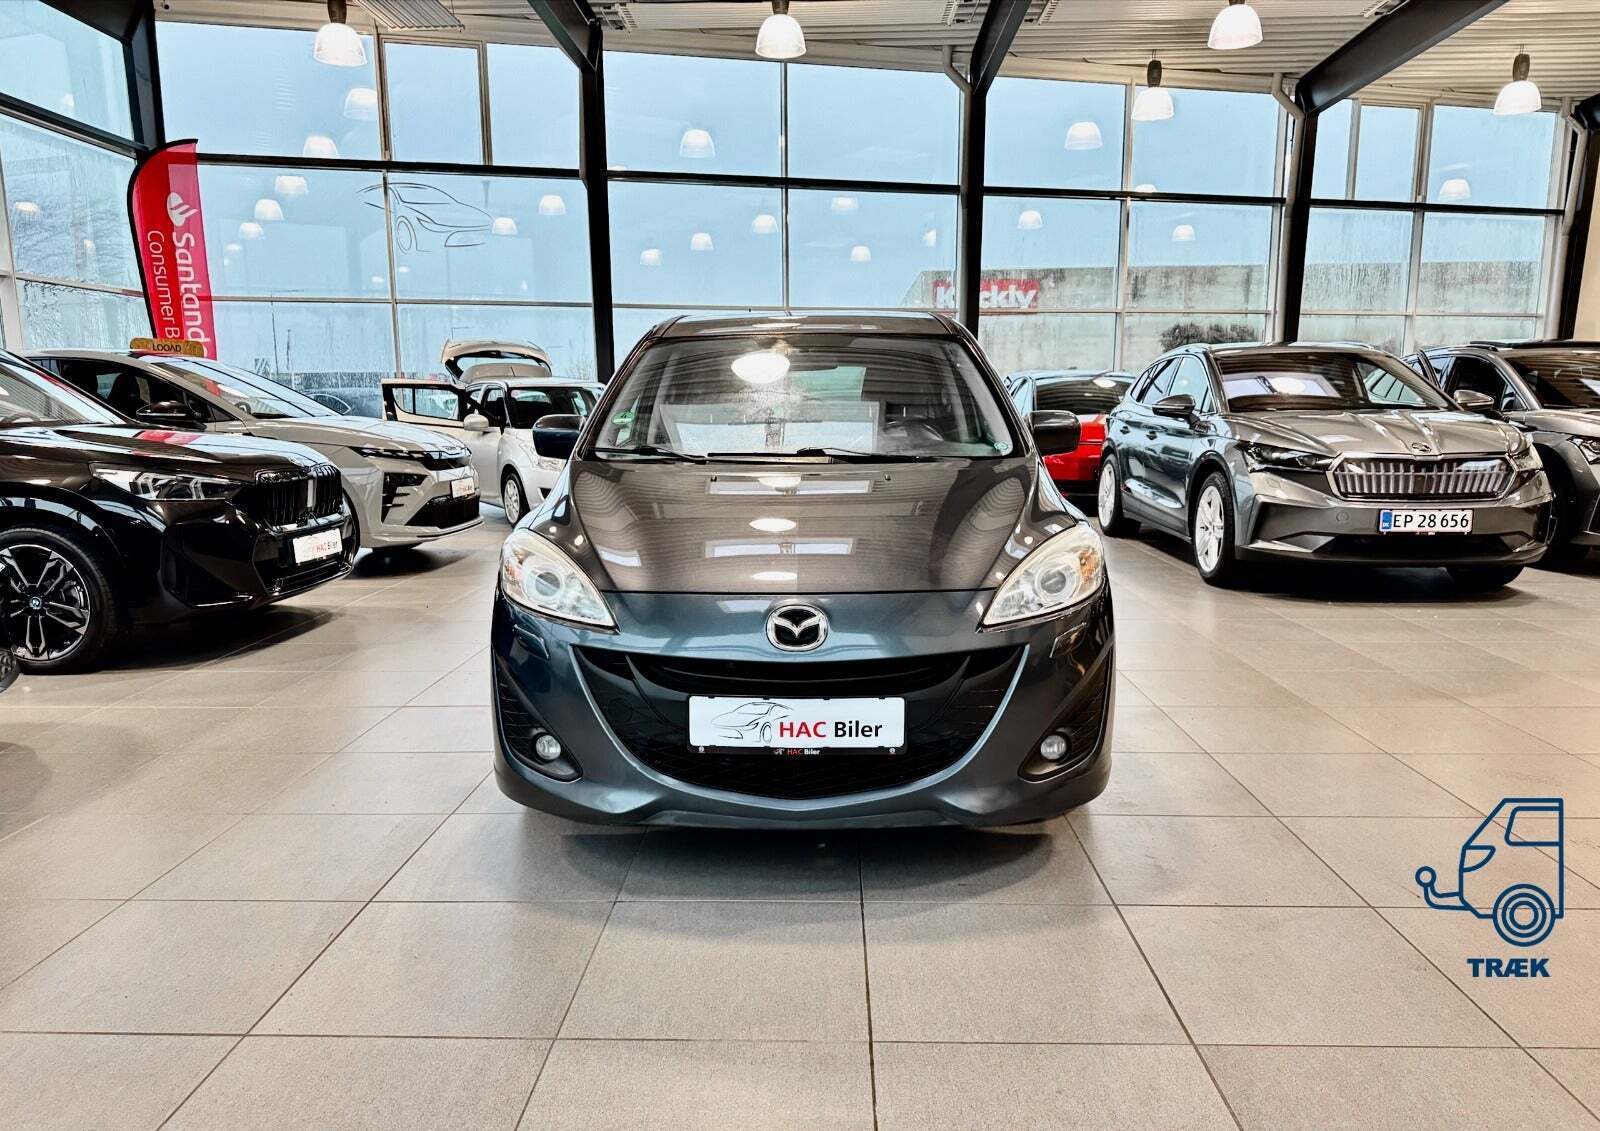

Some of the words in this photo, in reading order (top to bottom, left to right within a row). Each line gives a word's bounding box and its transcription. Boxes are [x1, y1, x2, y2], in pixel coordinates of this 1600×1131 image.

[147, 230, 176, 324] Consumer
[165, 327, 181, 340] B
[936, 284, 1037, 309] Kckly
[1393, 514, 1413, 528] EP
[1417, 513, 1437, 528] 28
[1440, 513, 1469, 528] 656
[778, 721, 827, 738] HAC
[834, 720, 883, 738] Biler
